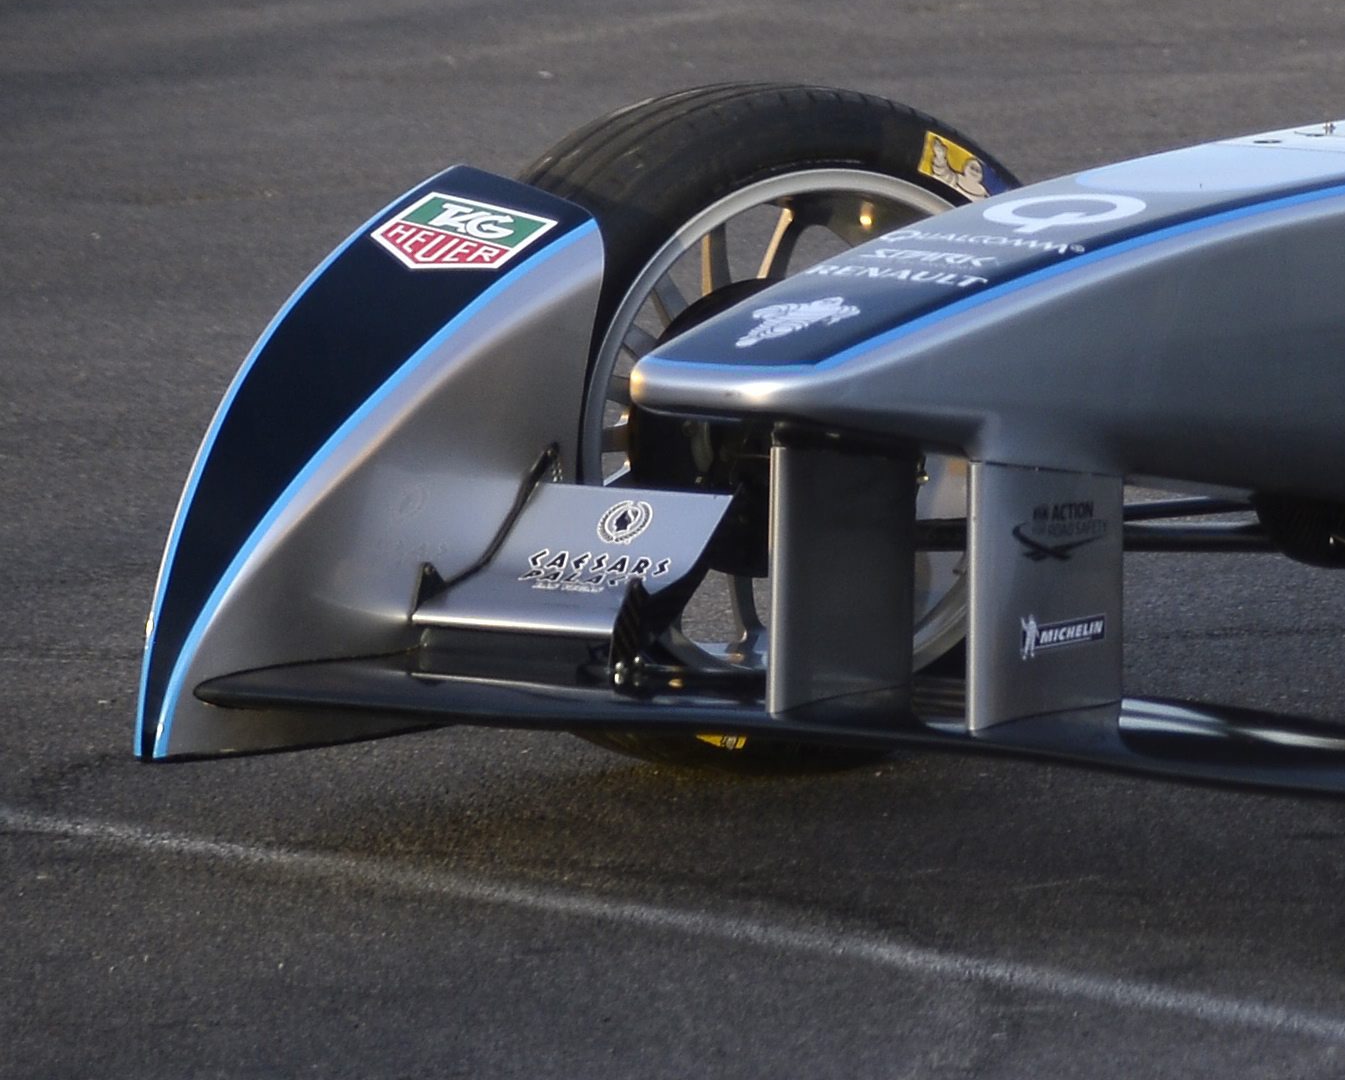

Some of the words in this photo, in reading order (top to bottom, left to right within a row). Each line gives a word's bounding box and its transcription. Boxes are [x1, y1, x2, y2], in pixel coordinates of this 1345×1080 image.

[428, 203, 515, 239] TAG
[387, 222, 501, 263] HEUER
[805, 265, 988, 287] RENAULT
[529, 549, 672, 577] CAESARS
[518, 570, 646, 586] PALAC
[1040, 620, 1104, 644] MICHELIN
